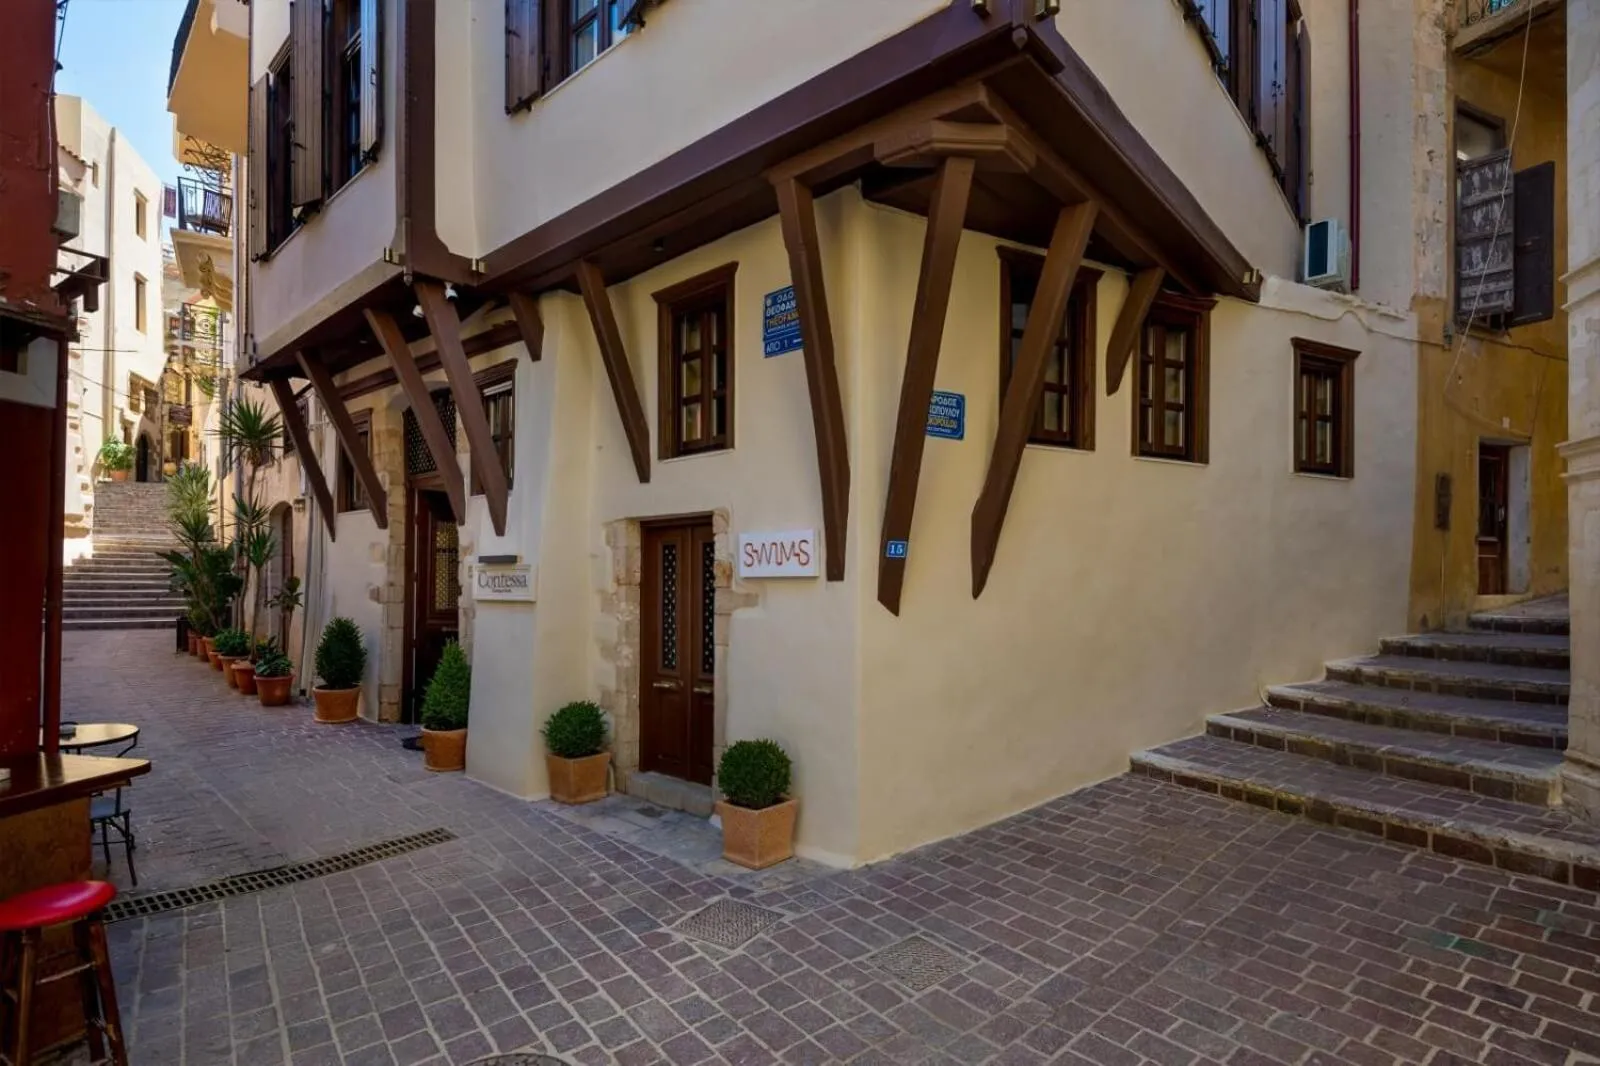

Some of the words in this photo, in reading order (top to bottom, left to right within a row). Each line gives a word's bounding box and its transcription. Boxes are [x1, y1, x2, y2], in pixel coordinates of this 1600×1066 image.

[777, 291, 794, 303] ΟΔΟ
[766, 300, 797, 317] ΘΕΟΦΑΝ
[477, 571, 528, 588] Contessa
